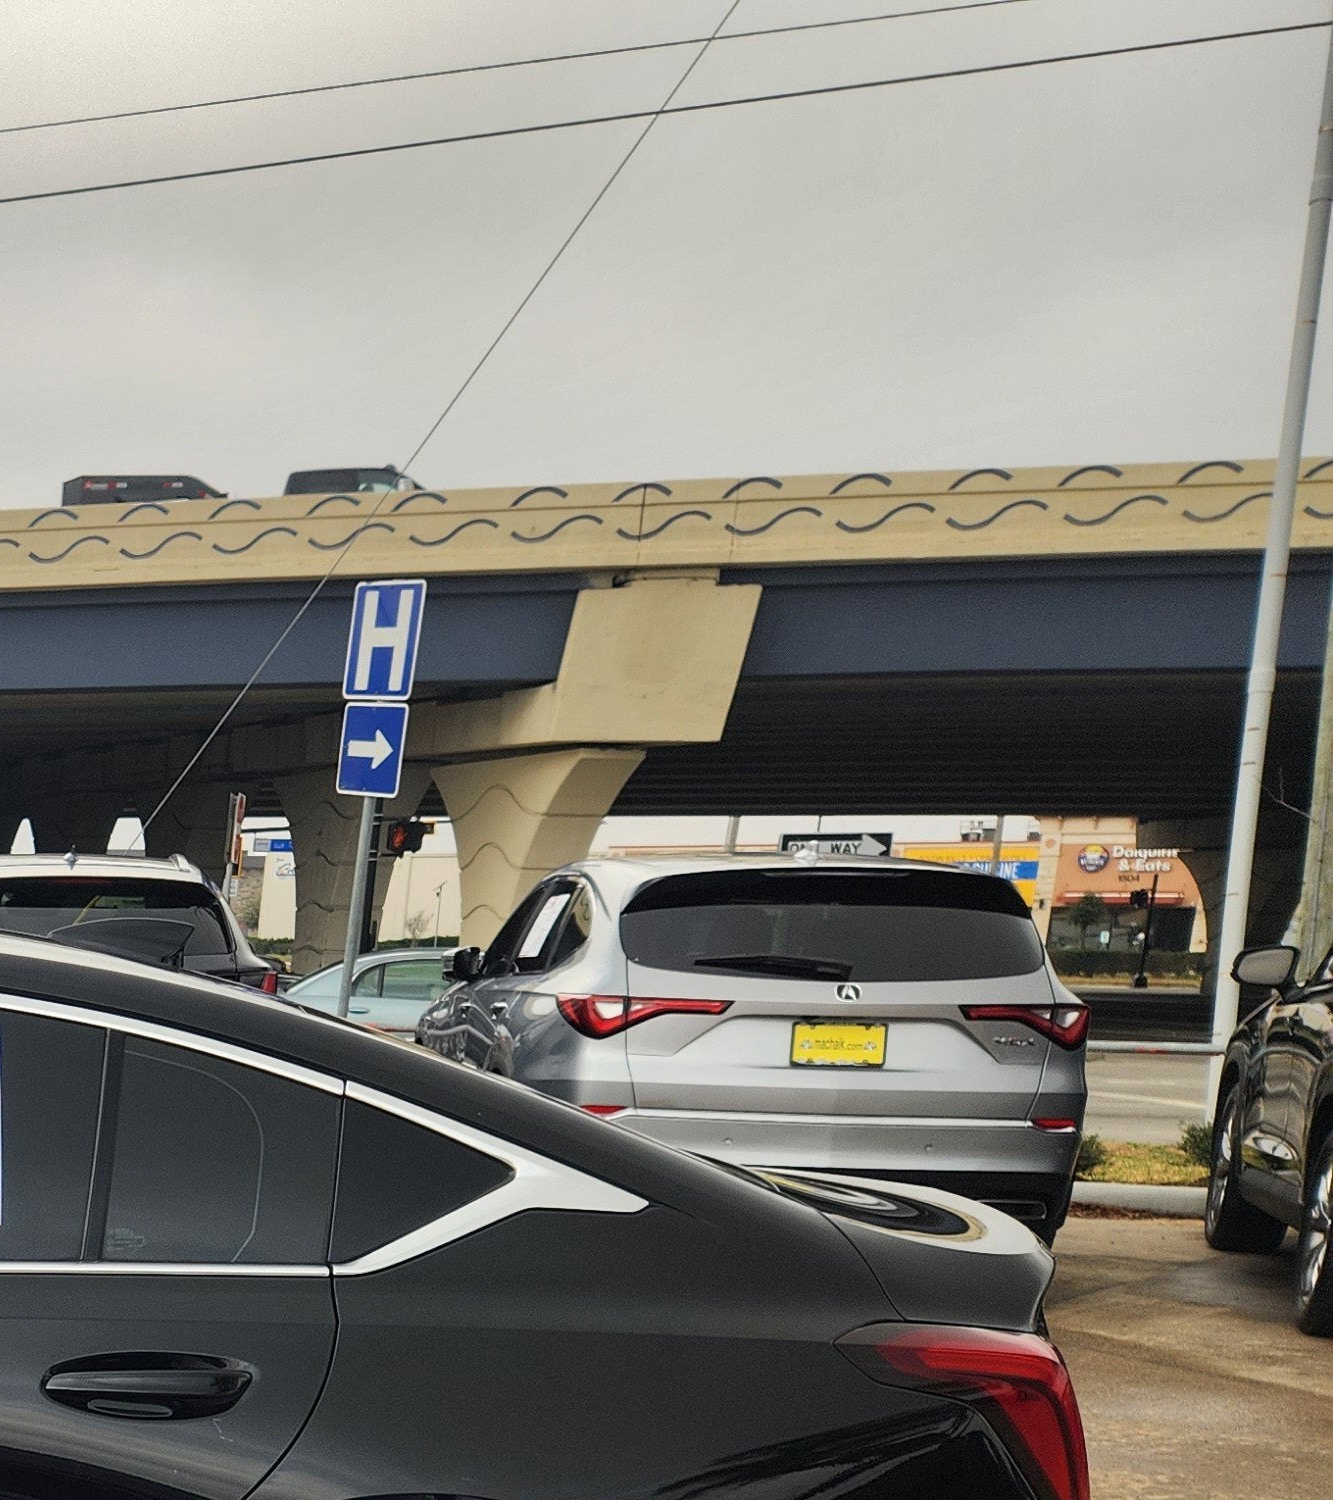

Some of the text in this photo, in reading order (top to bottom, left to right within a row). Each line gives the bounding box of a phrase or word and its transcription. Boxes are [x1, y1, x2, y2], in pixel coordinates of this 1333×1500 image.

[353, 588, 415, 692] H
[831, 843, 861, 854] WAY
[1118, 858, 1130, 871] &
[1135, 859, 1171, 871] Eats
